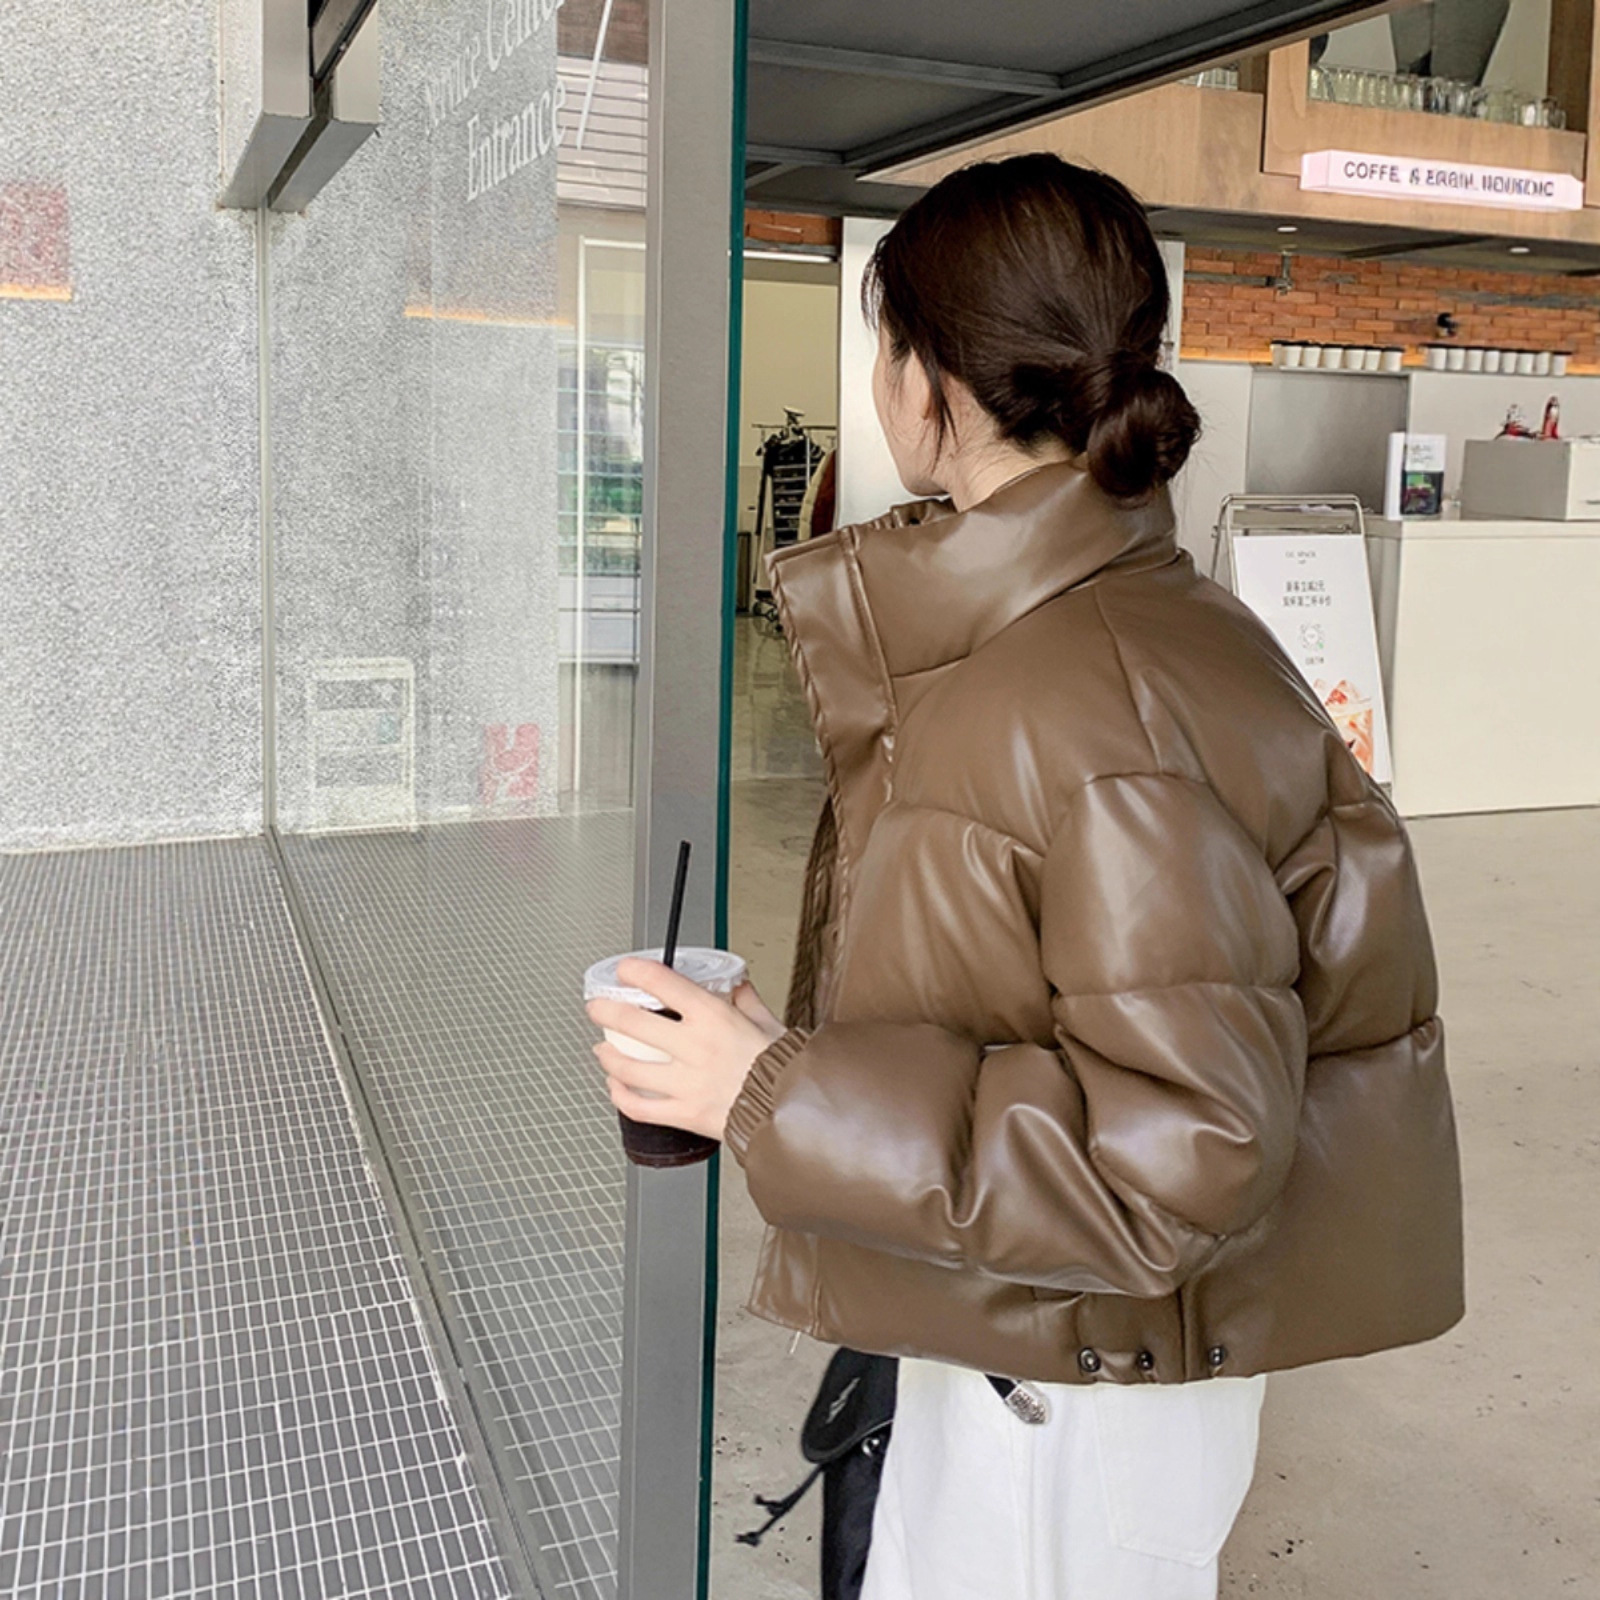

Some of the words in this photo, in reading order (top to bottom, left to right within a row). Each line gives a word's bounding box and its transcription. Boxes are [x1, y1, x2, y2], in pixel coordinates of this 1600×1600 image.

[487, 0, 565, 73] Cen
[467, 80, 566, 203] Entrance
[1343, 161, 1401, 184] COFFE
